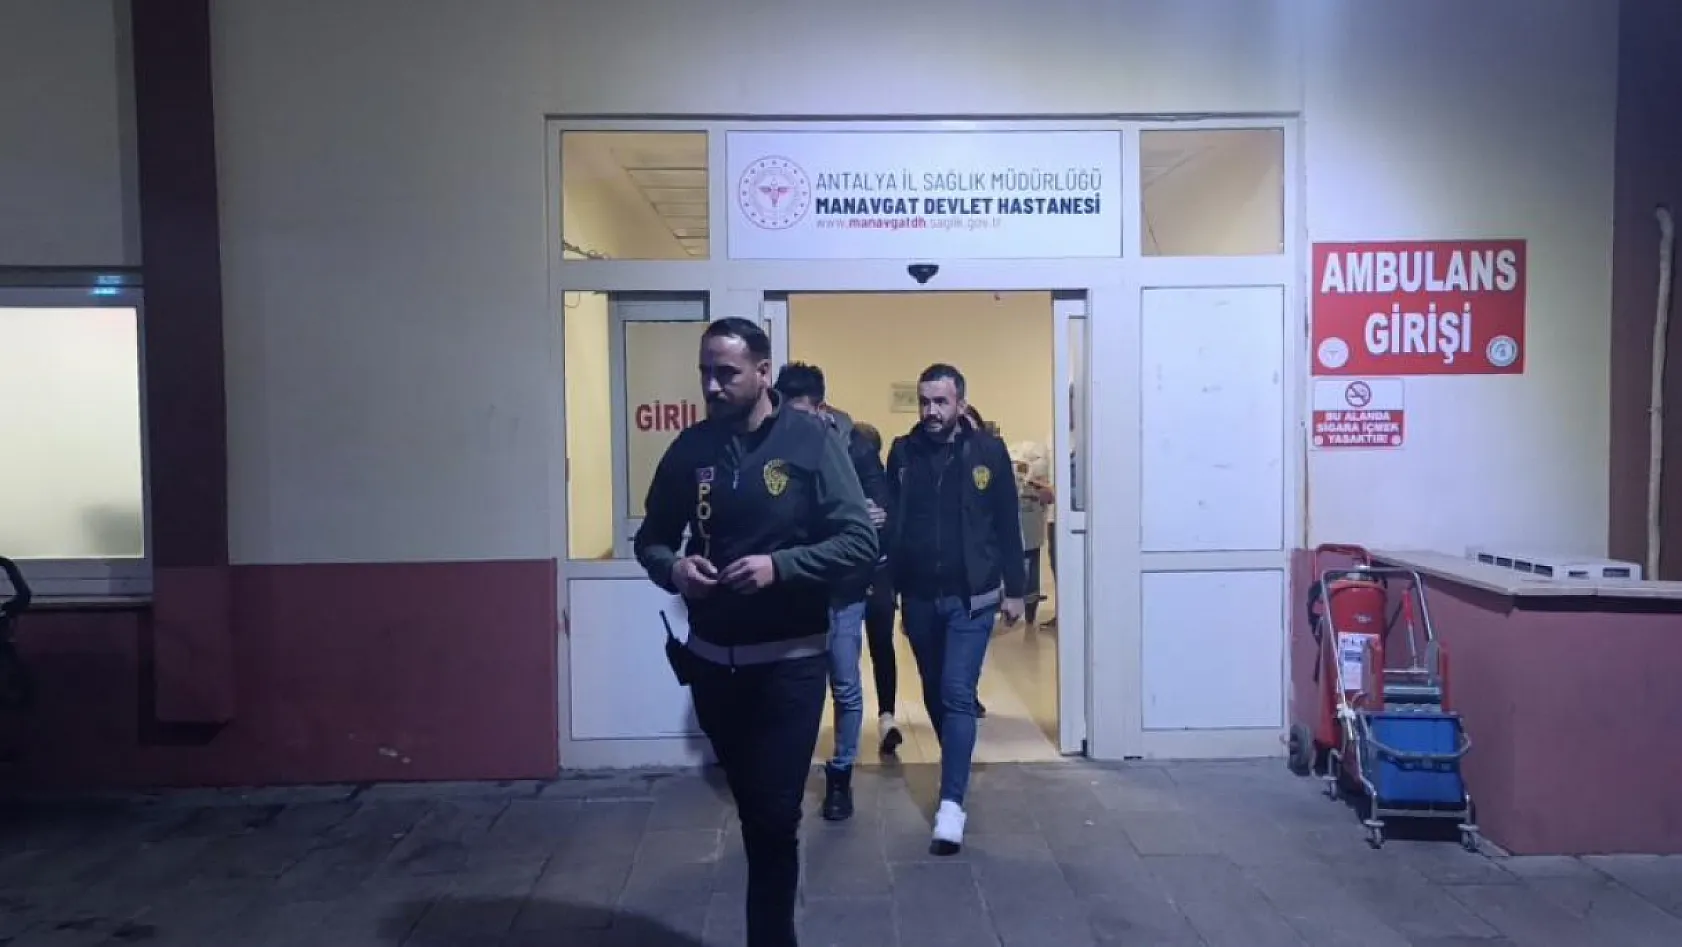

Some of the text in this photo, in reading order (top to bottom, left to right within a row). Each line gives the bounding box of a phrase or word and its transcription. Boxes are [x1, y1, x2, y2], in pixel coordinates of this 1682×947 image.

[816, 167, 1102, 192] ANTALYA İL SAĞLIK MÜDÜRLÜĞÜ
[815, 192, 1100, 214] MANAVGAT DEVLET HASTANESİ
[1320, 249, 1518, 293] AMBULANS
[1365, 301, 1471, 364] GİRİŞİ
[1325, 411, 1391, 421] BU ALANDA
